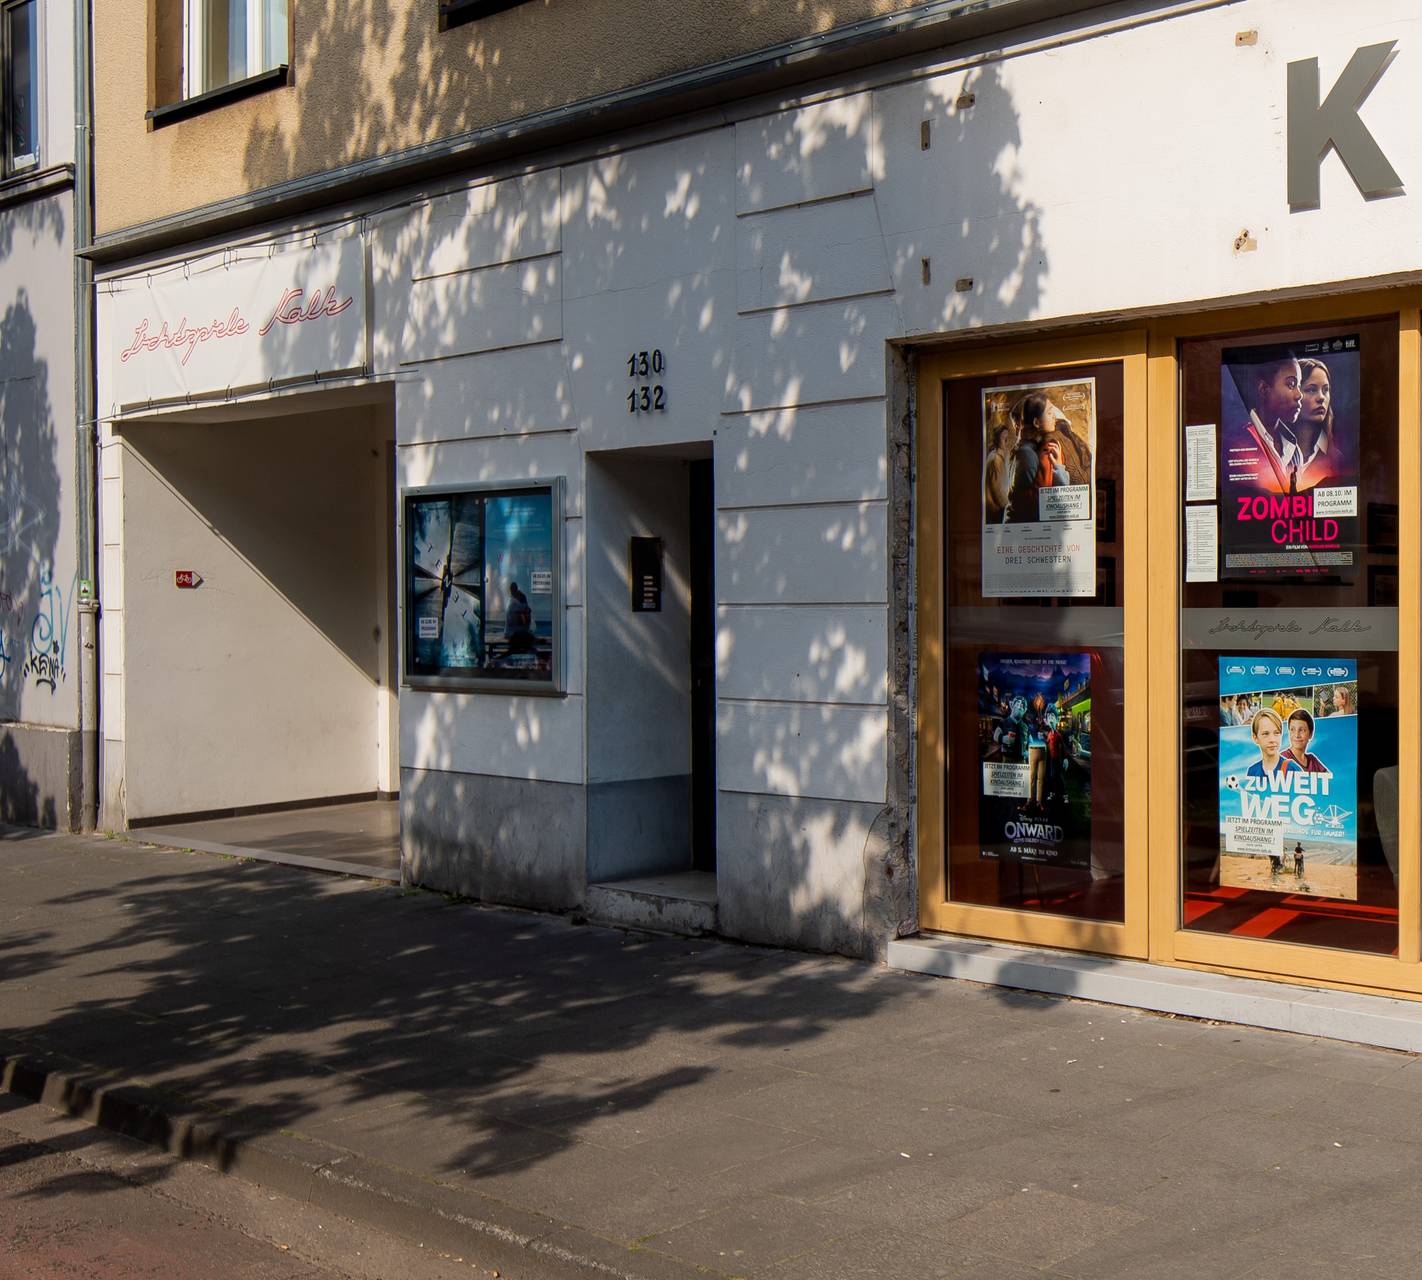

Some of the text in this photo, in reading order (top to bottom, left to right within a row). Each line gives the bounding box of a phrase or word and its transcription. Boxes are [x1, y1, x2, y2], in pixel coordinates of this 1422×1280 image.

[258, 283, 353, 337] Kalk
[627, 349, 664, 377] 130
[627, 385, 666, 413] 132
[1237, 496, 1313, 521] ZOMBI
[1317, 500, 1352, 508] PROGRAMM
[1271, 519, 1339, 544] CHILD
[996, 543, 1080, 554] EINE GESCHICHTE VON
[1005, 555, 1072, 565] DREI SCHWESTERN
[1308, 616, 1372, 635] Kalk
[1245, 770, 1333, 795] ZU WEIT
[1240, 790, 1316, 826] WEG
[1004, 821, 1064, 843] ONWARD
[1235, 826, 1265, 834] SPIELZEITEN
[1250, 818, 1283, 826] PROGRAMM
[1233, 835, 1272, 843] KINOAUSHANG
